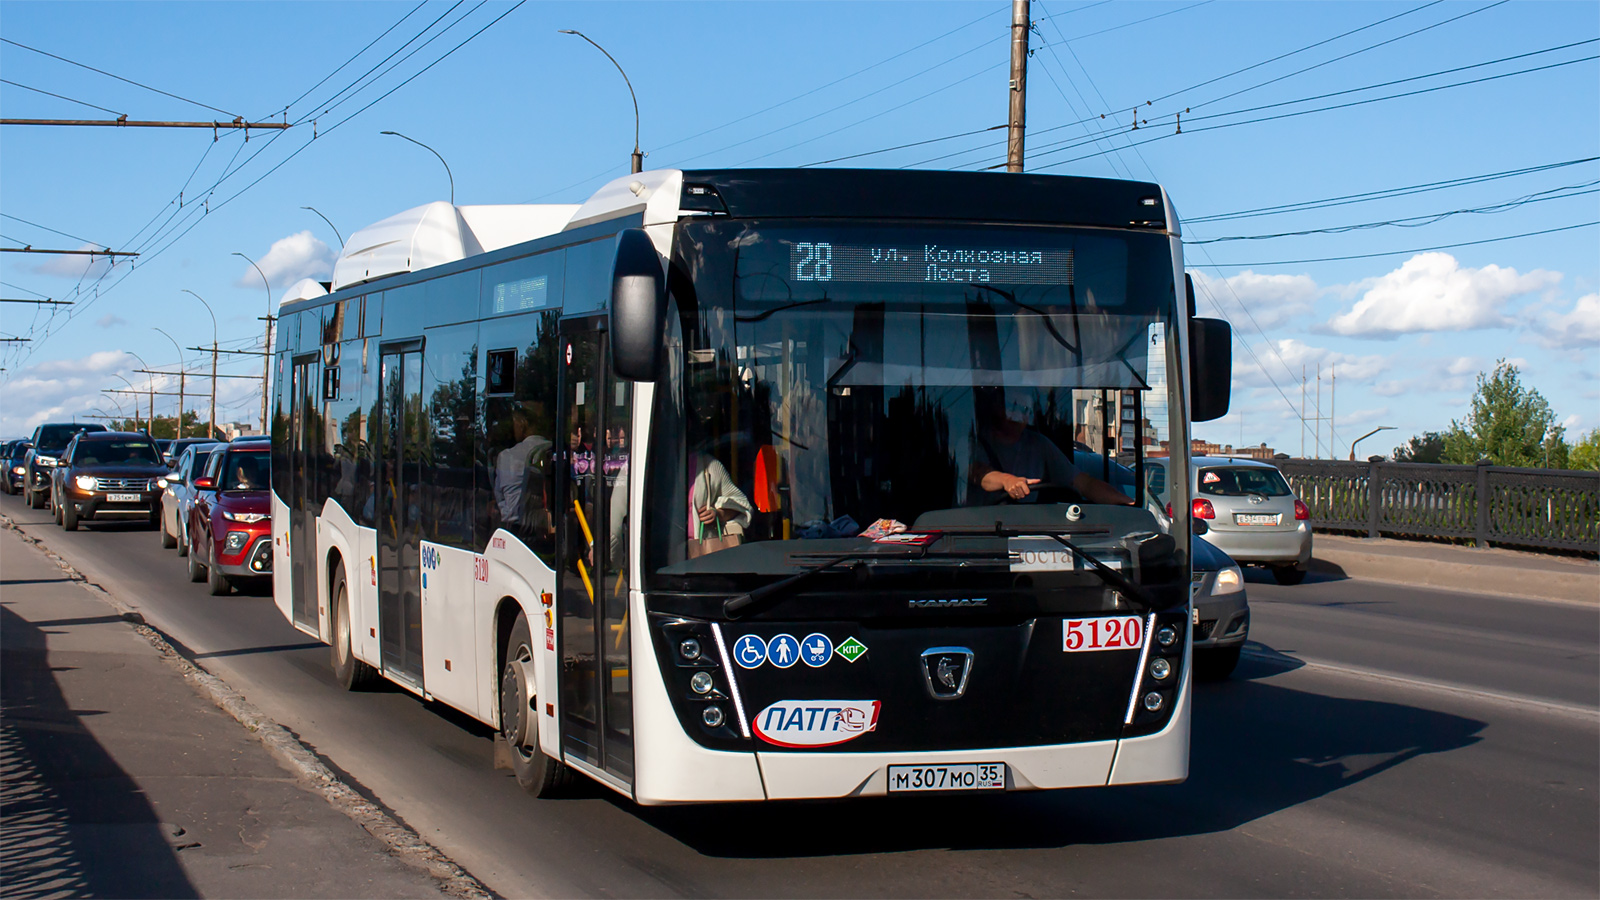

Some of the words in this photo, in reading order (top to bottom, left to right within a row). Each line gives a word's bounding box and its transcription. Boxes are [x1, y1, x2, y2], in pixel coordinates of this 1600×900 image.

[796, 242, 832, 281] 28
[870, 248, 909, 263] ул.
[924, 244, 1042, 264] Колхозная
[925, 263, 990, 282] Лоста
[475, 557, 489, 583] 5120
[908, 598, 988, 608] KAMAZ
[1065, 618, 1141, 650] 5120
[842, 645, 861, 654] КПГ
[763, 707, 842, 731] ПАТП
[980, 766, 998, 780] 35
